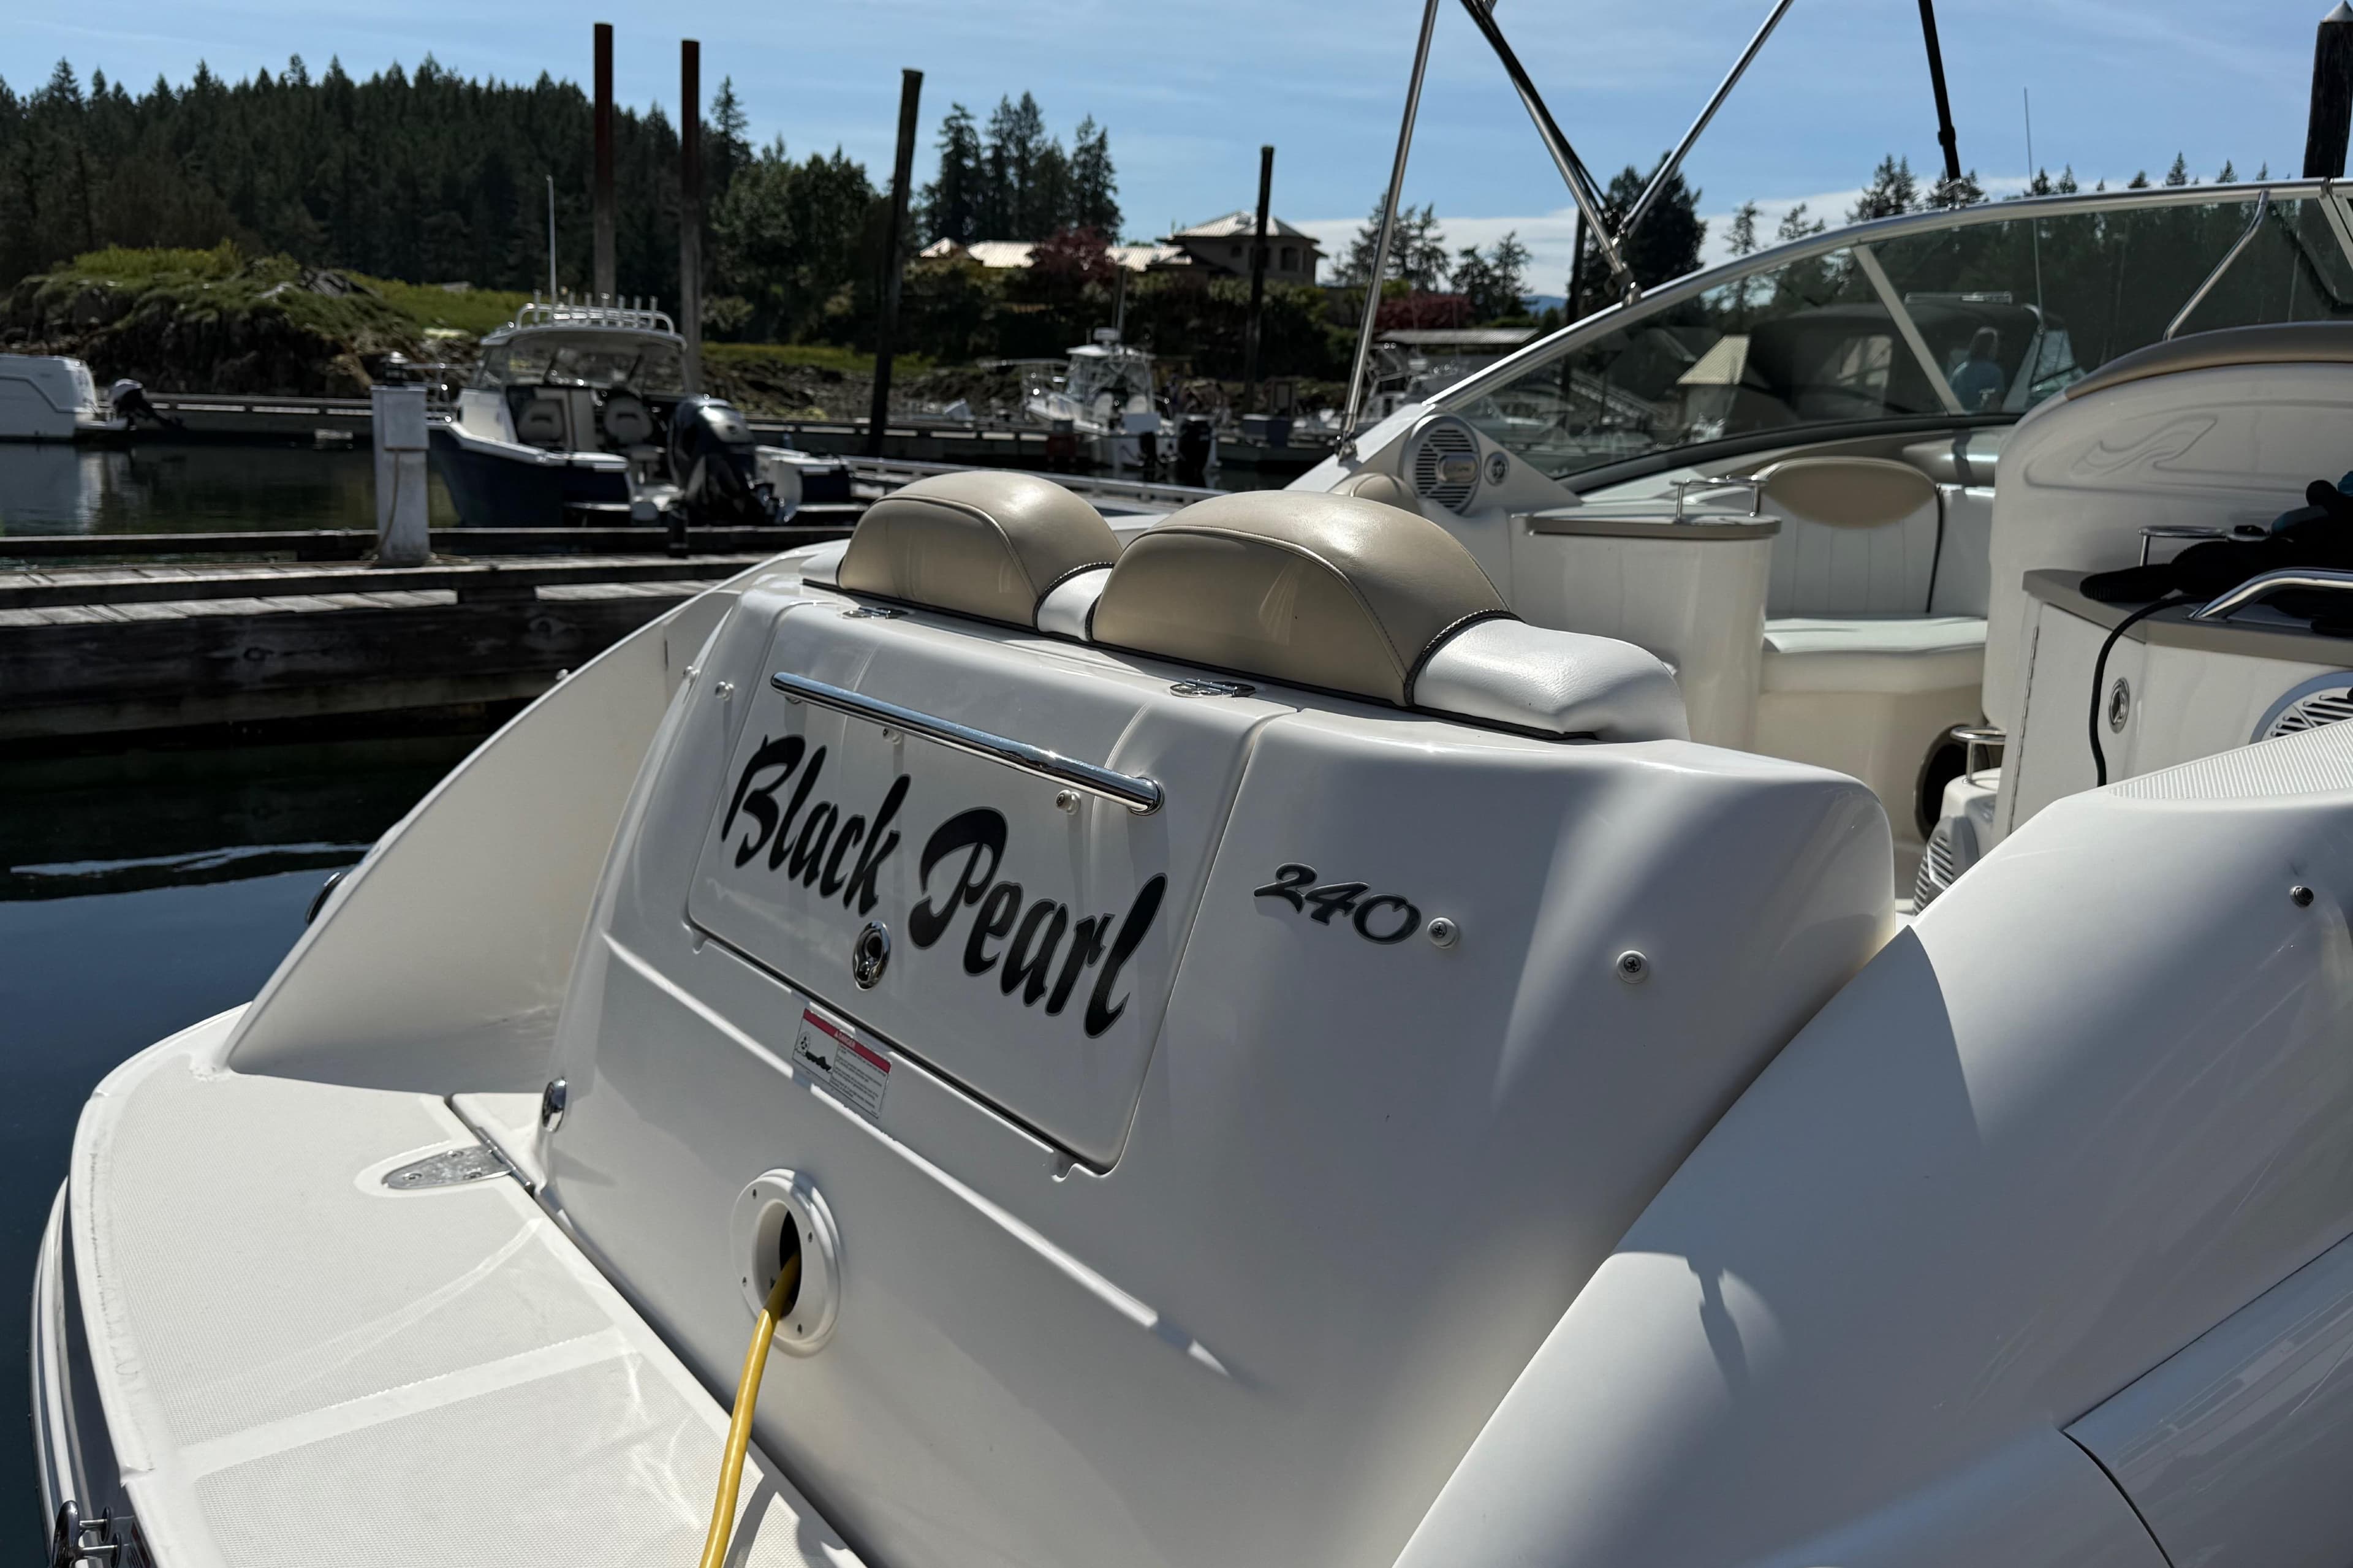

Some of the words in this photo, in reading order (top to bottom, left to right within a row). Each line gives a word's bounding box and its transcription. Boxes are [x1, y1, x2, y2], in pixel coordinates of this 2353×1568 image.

[720, 733, 912, 918] Black
[907, 806, 1169, 1040] Pearl
[1253, 863, 1422, 945] 240
